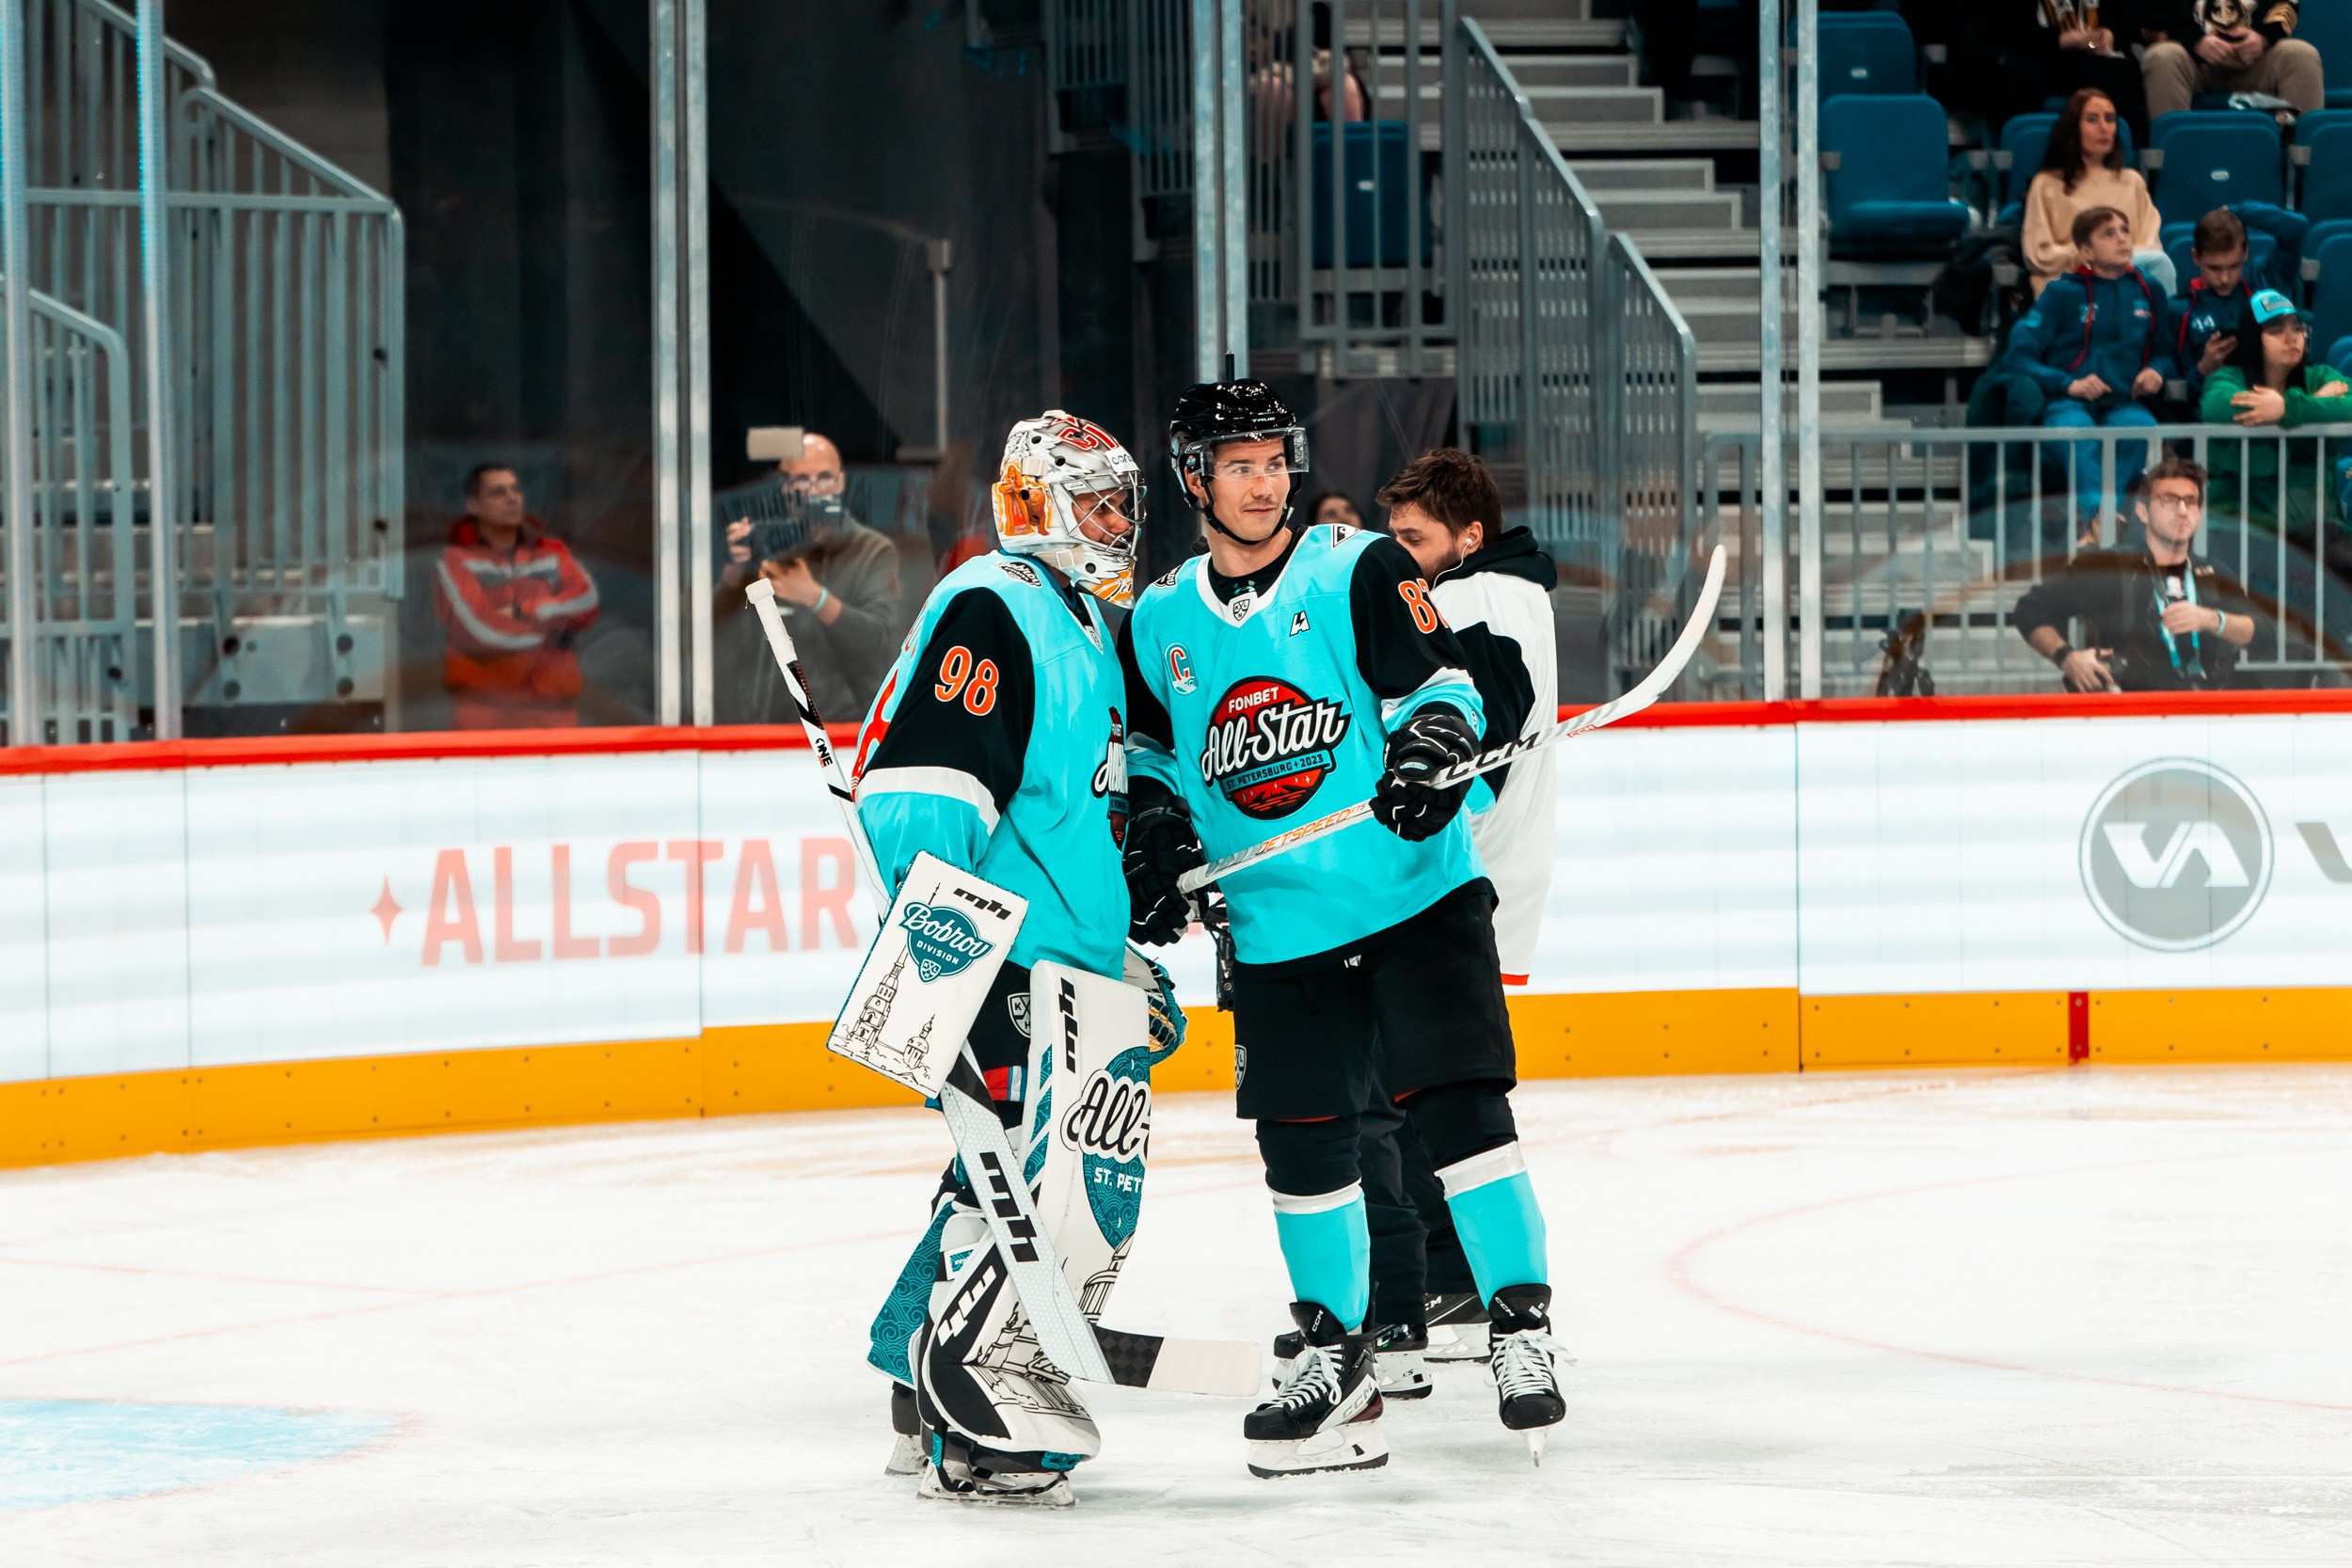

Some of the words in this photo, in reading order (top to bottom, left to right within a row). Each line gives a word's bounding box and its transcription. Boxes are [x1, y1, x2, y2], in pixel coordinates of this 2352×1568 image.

[934, 645, 999, 716] 98
[1169, 646, 1190, 681] C
[1228, 687, 1279, 713] FONBET
[1201, 702, 1344, 781] All-Star
[1446, 731, 1542, 780] CCM
[1226, 780, 1237, 790] ST.
[1237, 761, 1293, 786] PETERSBURG
[1300, 753, 1324, 768] 2023
[1255, 808, 1352, 856] JETSPEED
[420, 836, 860, 968] ALLSTAR
[903, 904, 989, 957] Bobrov
[916, 941, 960, 965] DIVISION
[1094, 1166, 1113, 1186] ST.
[1311, 1309, 1324, 1333] CCM
[1495, 1296, 1516, 1317] CCM
[1342, 1383, 1374, 1419] CCM
